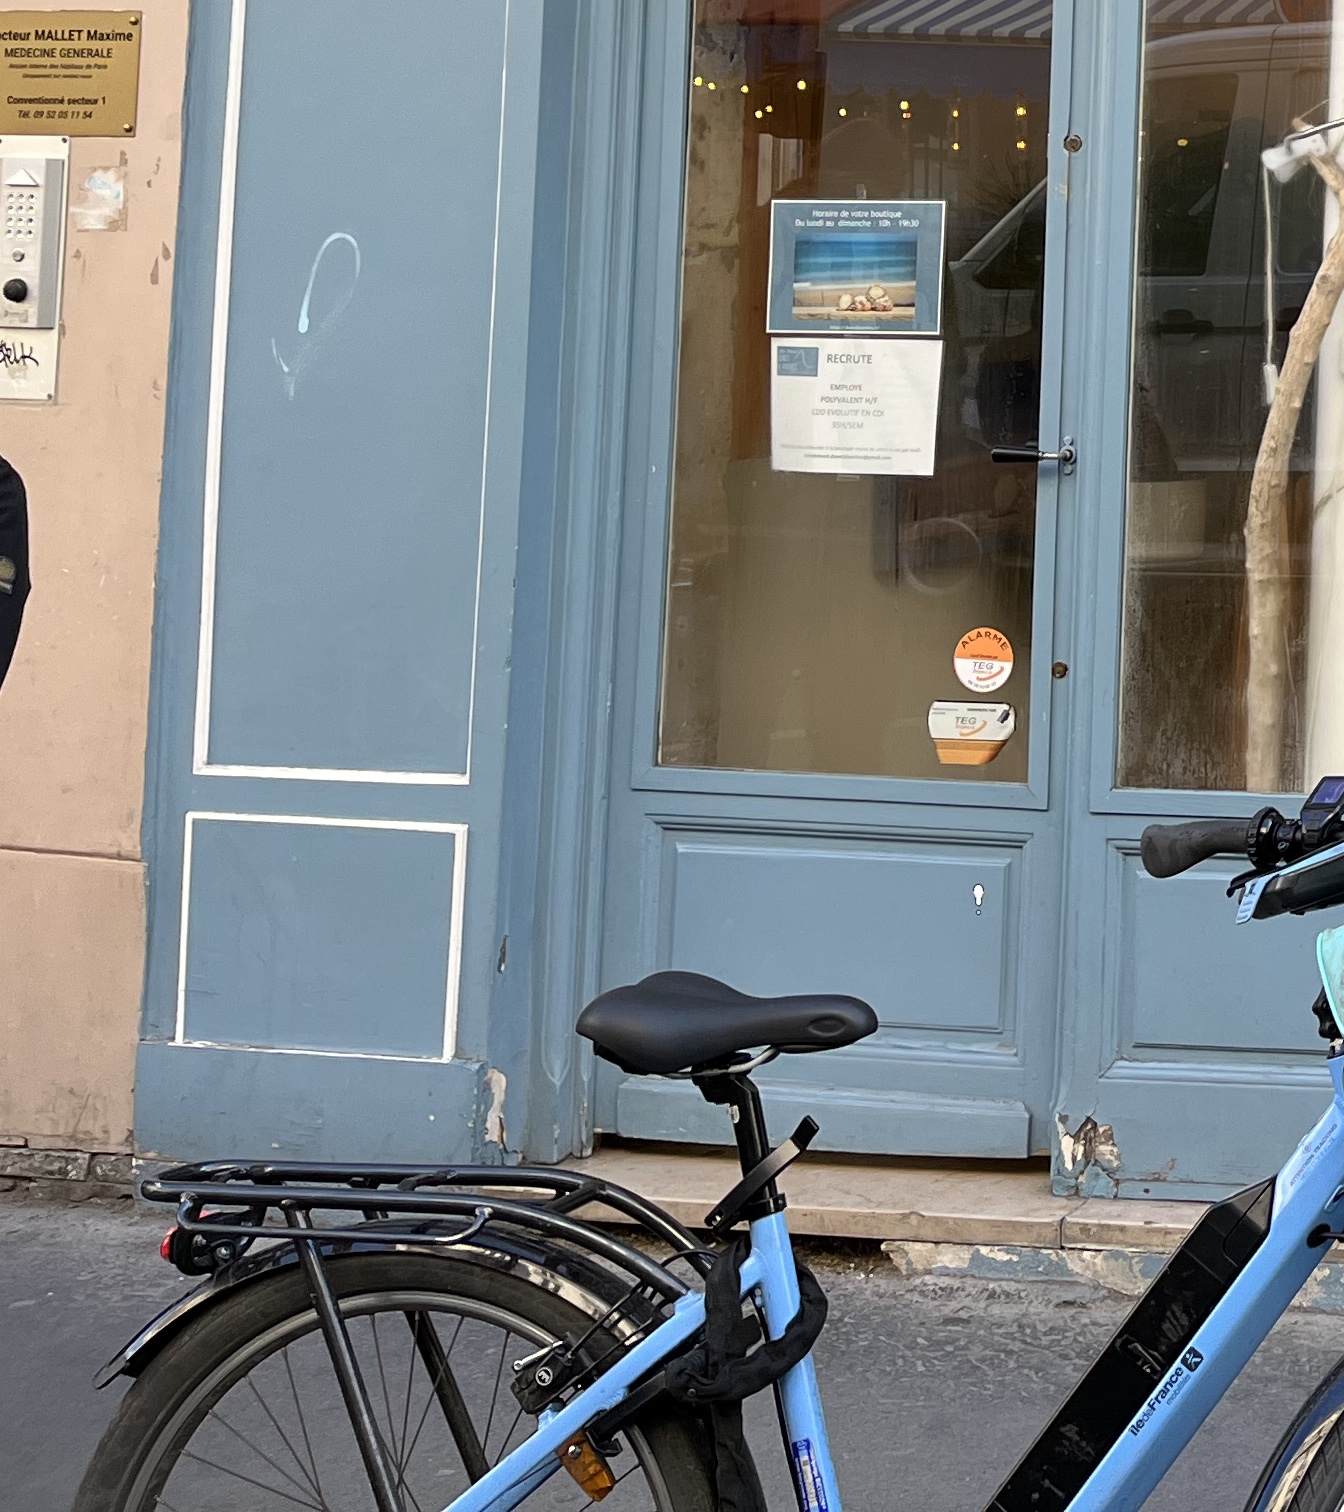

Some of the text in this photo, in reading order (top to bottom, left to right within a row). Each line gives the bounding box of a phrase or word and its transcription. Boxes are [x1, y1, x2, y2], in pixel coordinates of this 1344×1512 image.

[34, 29, 84, 42] MALLET
[86, 29, 133, 42] Maxime
[4, 48, 113, 58] MEDECINE GENERALE
[7, 95, 106, 106] Conventionné secteur 1
[70, 110, 80, 119] 11
[82, 110, 93, 120] 54
[840, 210, 849, 218] de
[870, 210, 902, 219] boutique
[826, 354, 873, 364] RECRUTE
[961, 630, 1009, 651] ALARME
[972, 661, 994, 671] TEG
[955, 716, 977, 725] TEG
